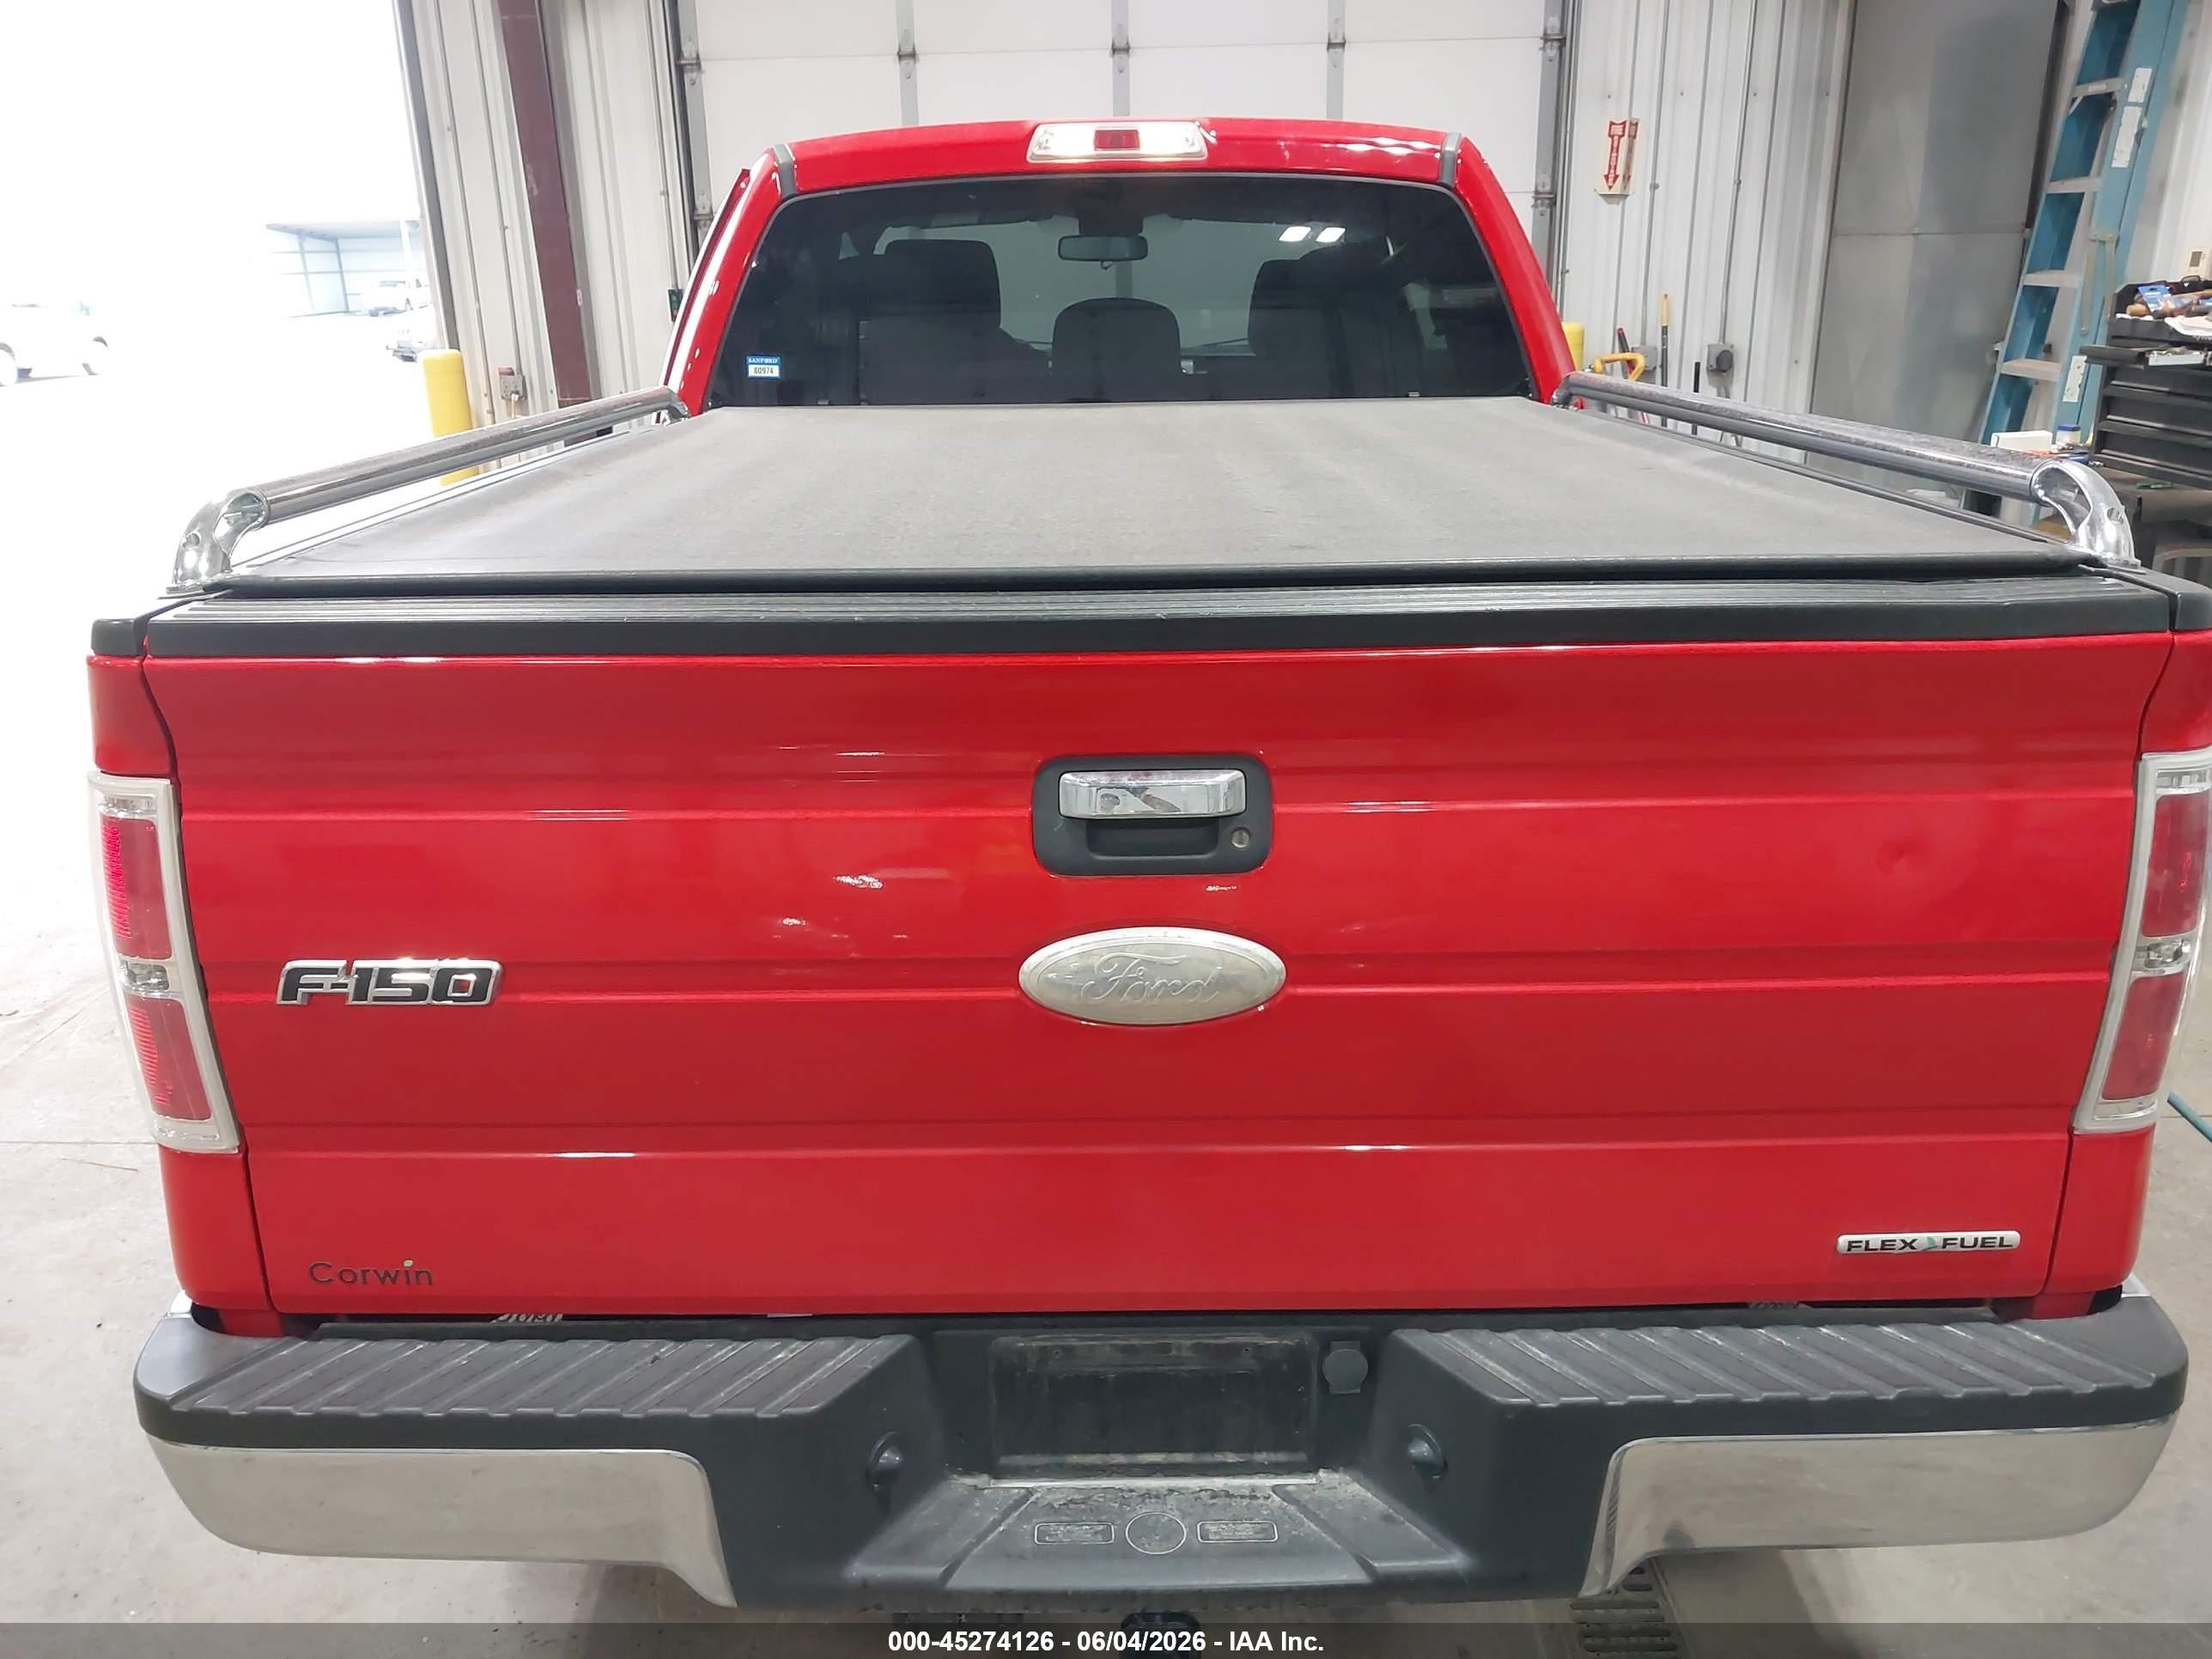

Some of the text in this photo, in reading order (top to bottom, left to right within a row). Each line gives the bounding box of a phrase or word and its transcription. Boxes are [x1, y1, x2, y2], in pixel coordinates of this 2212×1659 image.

[276, 957, 504, 1006] F-150
[1080, 951, 1220, 1005] Ford
[1846, 1236, 2014, 1252] FLEX FUEL
[308, 1258, 434, 1286] Corwin
